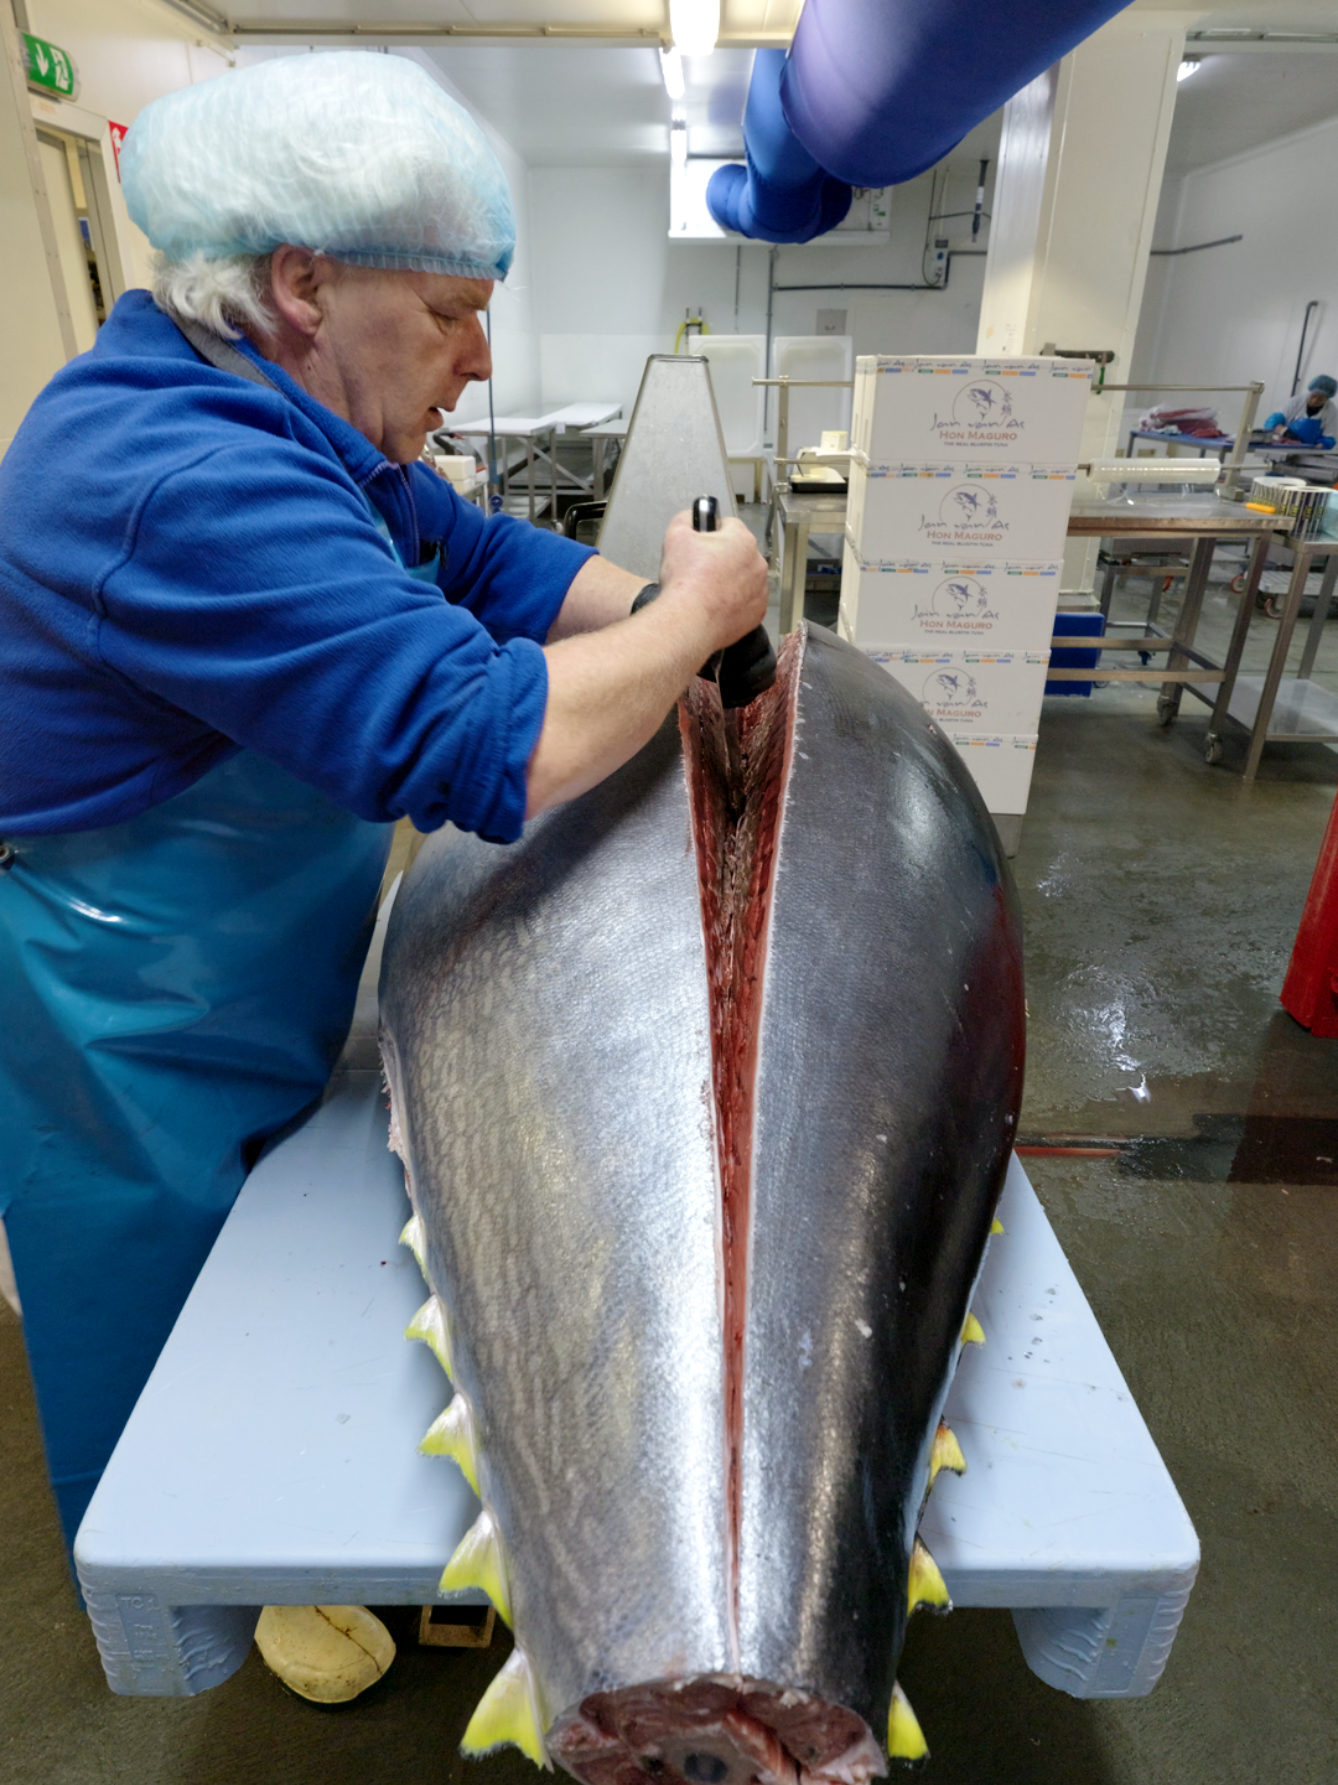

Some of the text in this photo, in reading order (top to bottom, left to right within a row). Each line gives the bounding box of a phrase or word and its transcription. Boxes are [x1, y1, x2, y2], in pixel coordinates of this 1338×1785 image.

[929, 413, 961, 432] Jan
[939, 430, 1018, 441] HON MAGURO
[926, 530, 1003, 542] HON MAGURO
[946, 620, 993, 631] MAGURO
